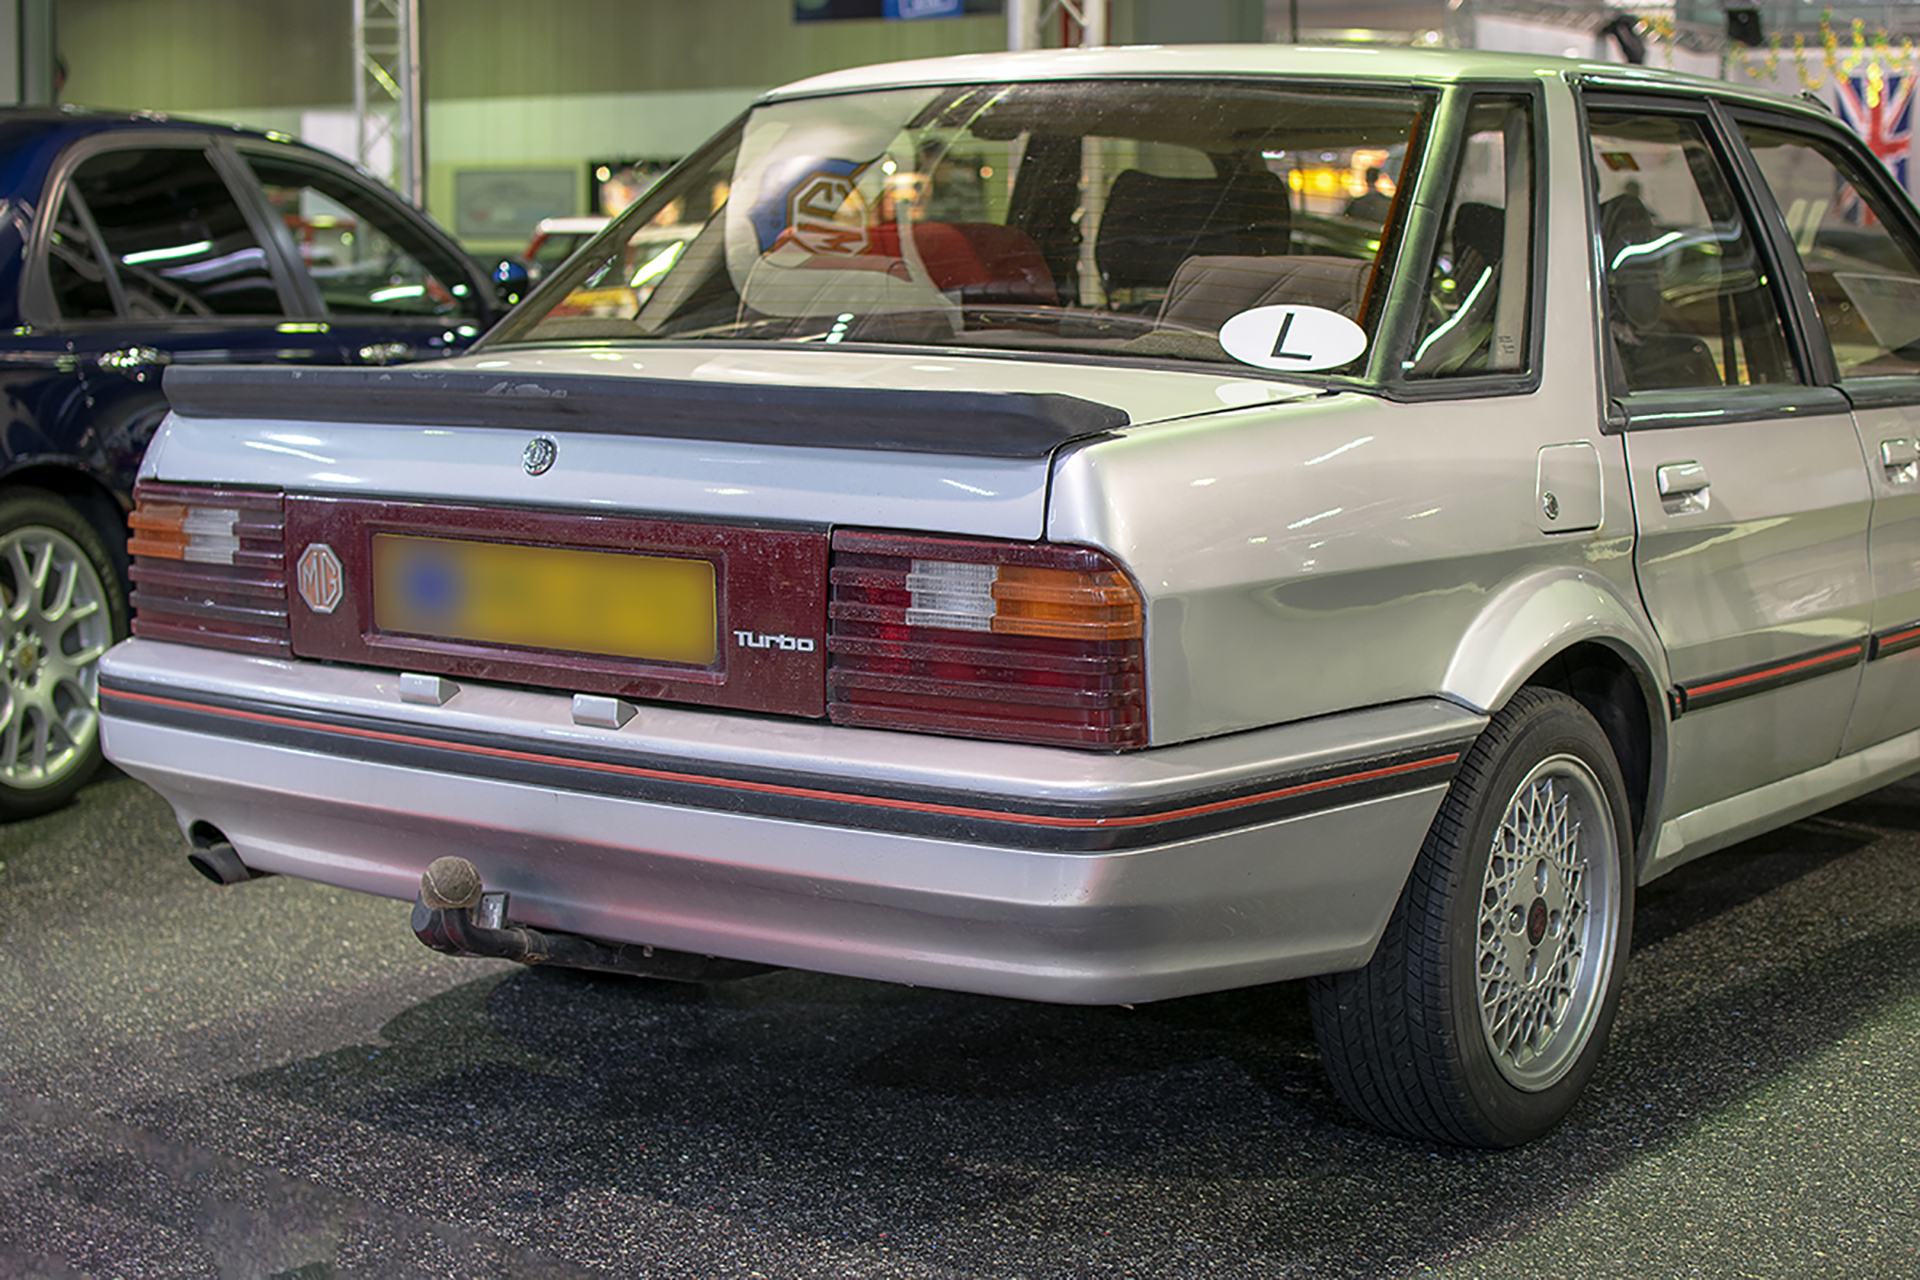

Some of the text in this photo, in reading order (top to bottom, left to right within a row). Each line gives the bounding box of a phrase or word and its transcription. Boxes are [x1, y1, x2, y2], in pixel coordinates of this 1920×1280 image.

[1270, 312, 1313, 361] L
[302, 551, 338, 605] MG
[733, 630, 815, 652] Turbo
